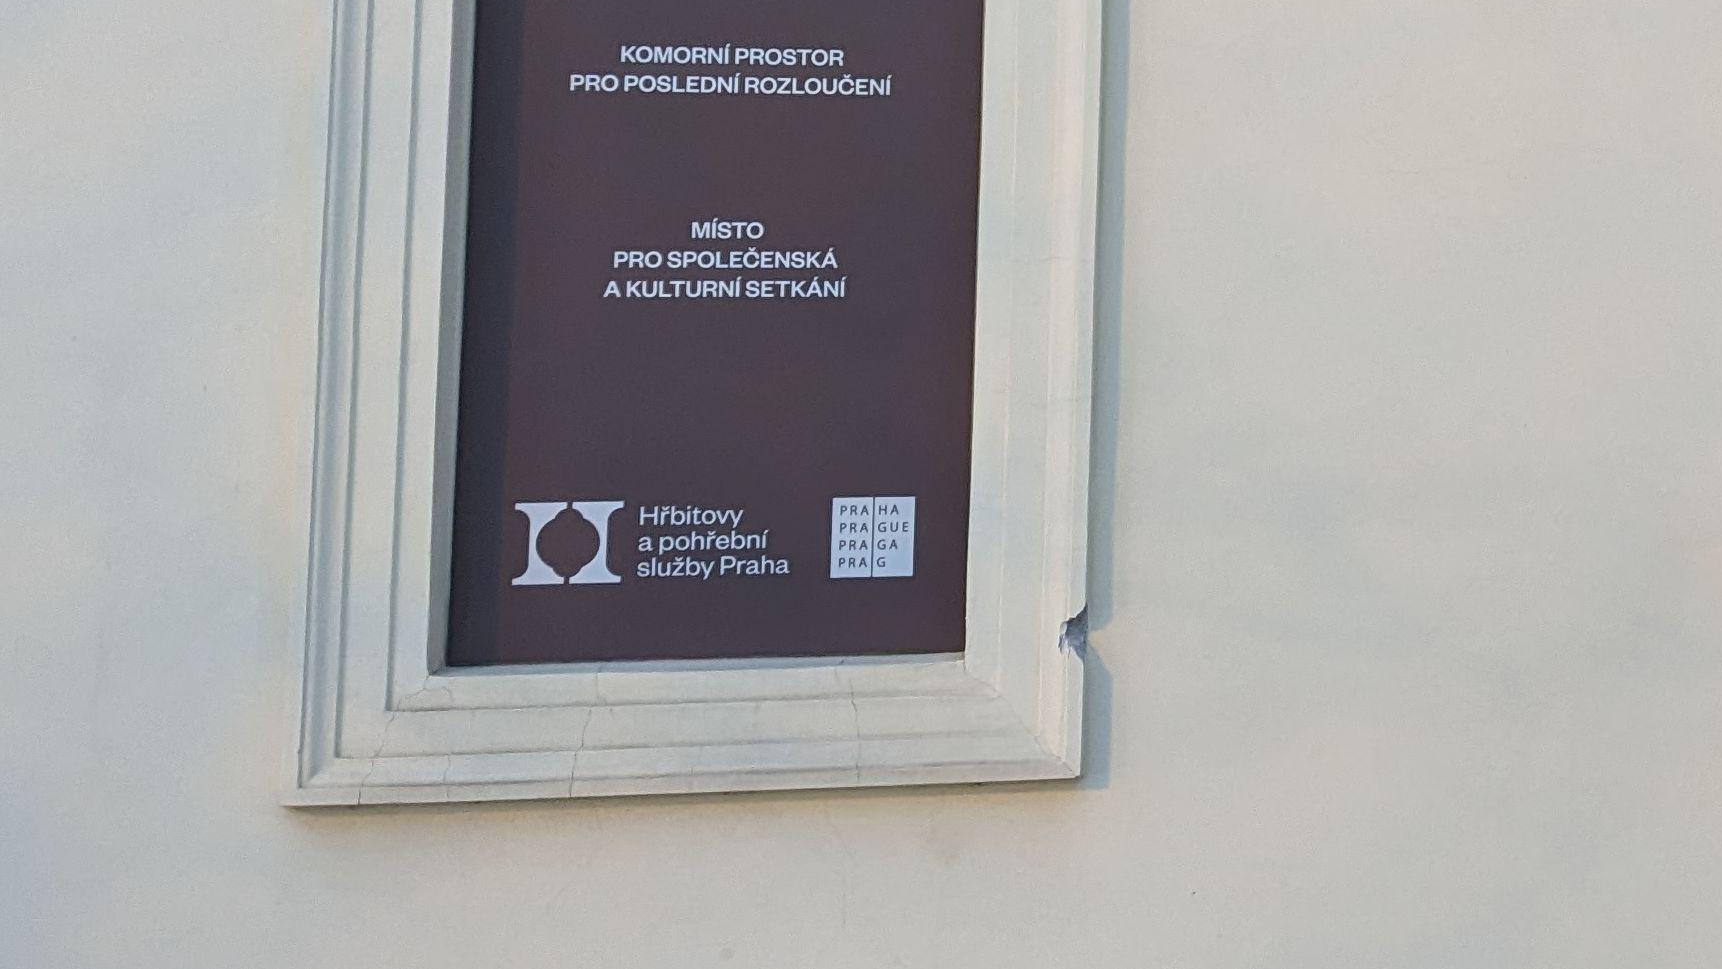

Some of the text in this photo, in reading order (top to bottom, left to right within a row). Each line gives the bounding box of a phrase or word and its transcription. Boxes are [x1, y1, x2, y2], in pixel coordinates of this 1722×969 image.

[620, 43, 844, 67] KOMORNÍ PROSTOR
[569, 72, 893, 96] PRO POSLEDNÍ ROZLOUČENÍ
[691, 217, 764, 240] MÍSTO
[613, 246, 838, 269] PRO SPOLEČENSKÁ
[603, 276, 847, 298] A KULTURNÍ SETKÁNÍ
[639, 505, 744, 529] Hřbitovy
[638, 529, 769, 555] a pohřební
[636, 554, 790, 580] služby Praha
